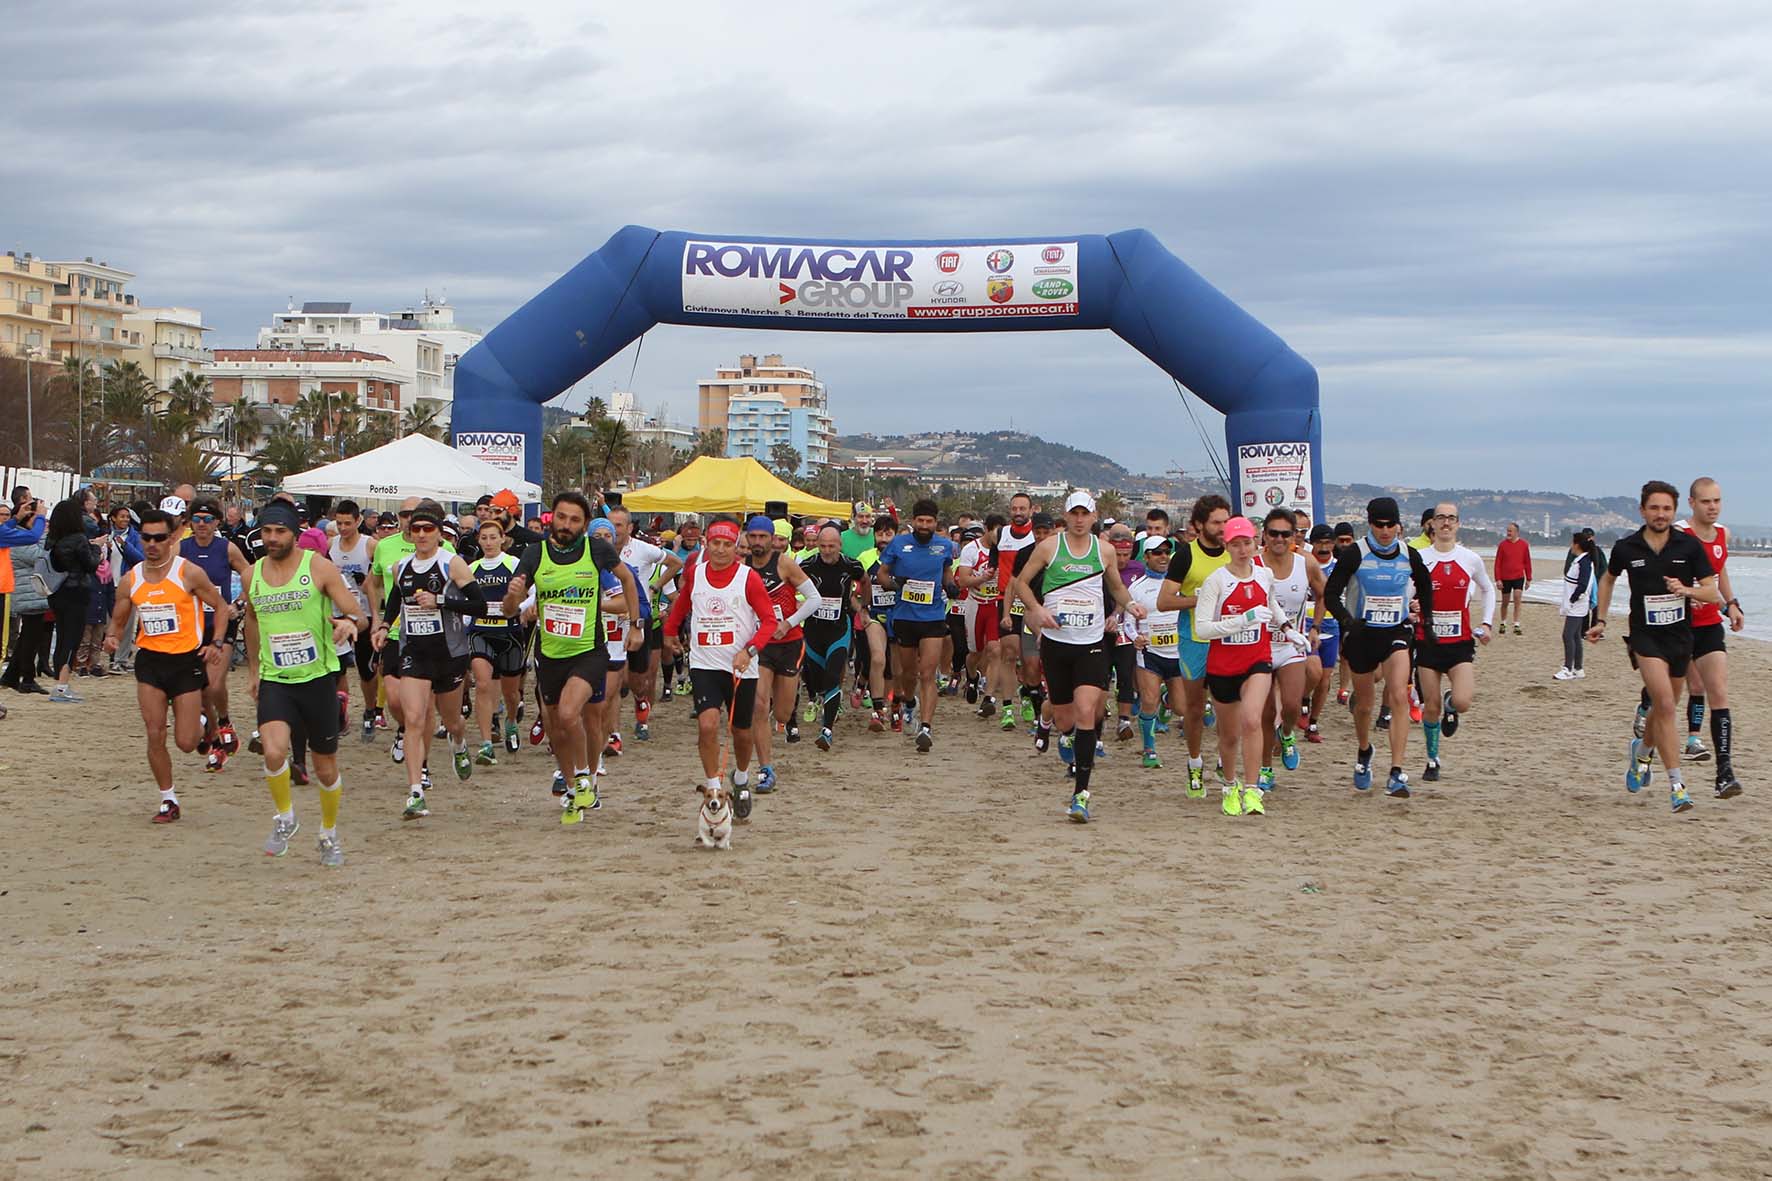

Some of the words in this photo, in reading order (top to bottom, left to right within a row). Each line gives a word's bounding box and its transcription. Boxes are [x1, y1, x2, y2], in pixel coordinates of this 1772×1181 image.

[686, 243, 914, 281] ROMACAR
[941, 255, 958, 269] FIAT
[1040, 281, 1062, 289] LAND
[798, 280, 914, 308] GROUP
[1041, 288, 1069, 296] ROVER
[684, 304, 738, 314] Civitanova
[741, 307, 780, 317] Marche
[797, 310, 851, 319] Benedetto
[914, 303, 1075, 318] www.grupporomacar.it
[458, 433, 522, 447] ROMACAR
[1240, 443, 1307, 459] ROMACAR
[369, 484, 398, 495] Porto85
[908, 592, 926, 602] 500
[818, 608, 835, 619] 1015
[1064, 614, 1090, 626] 1065
[1370, 611, 1395, 622] 1044
[1653, 610, 1679, 623] 1091
[410, 621, 436, 633] 1035
[553, 621, 572, 636] 301
[706, 631, 722, 645] 46
[1157, 635, 1174, 645] 501
[278, 650, 310, 666] 1053
